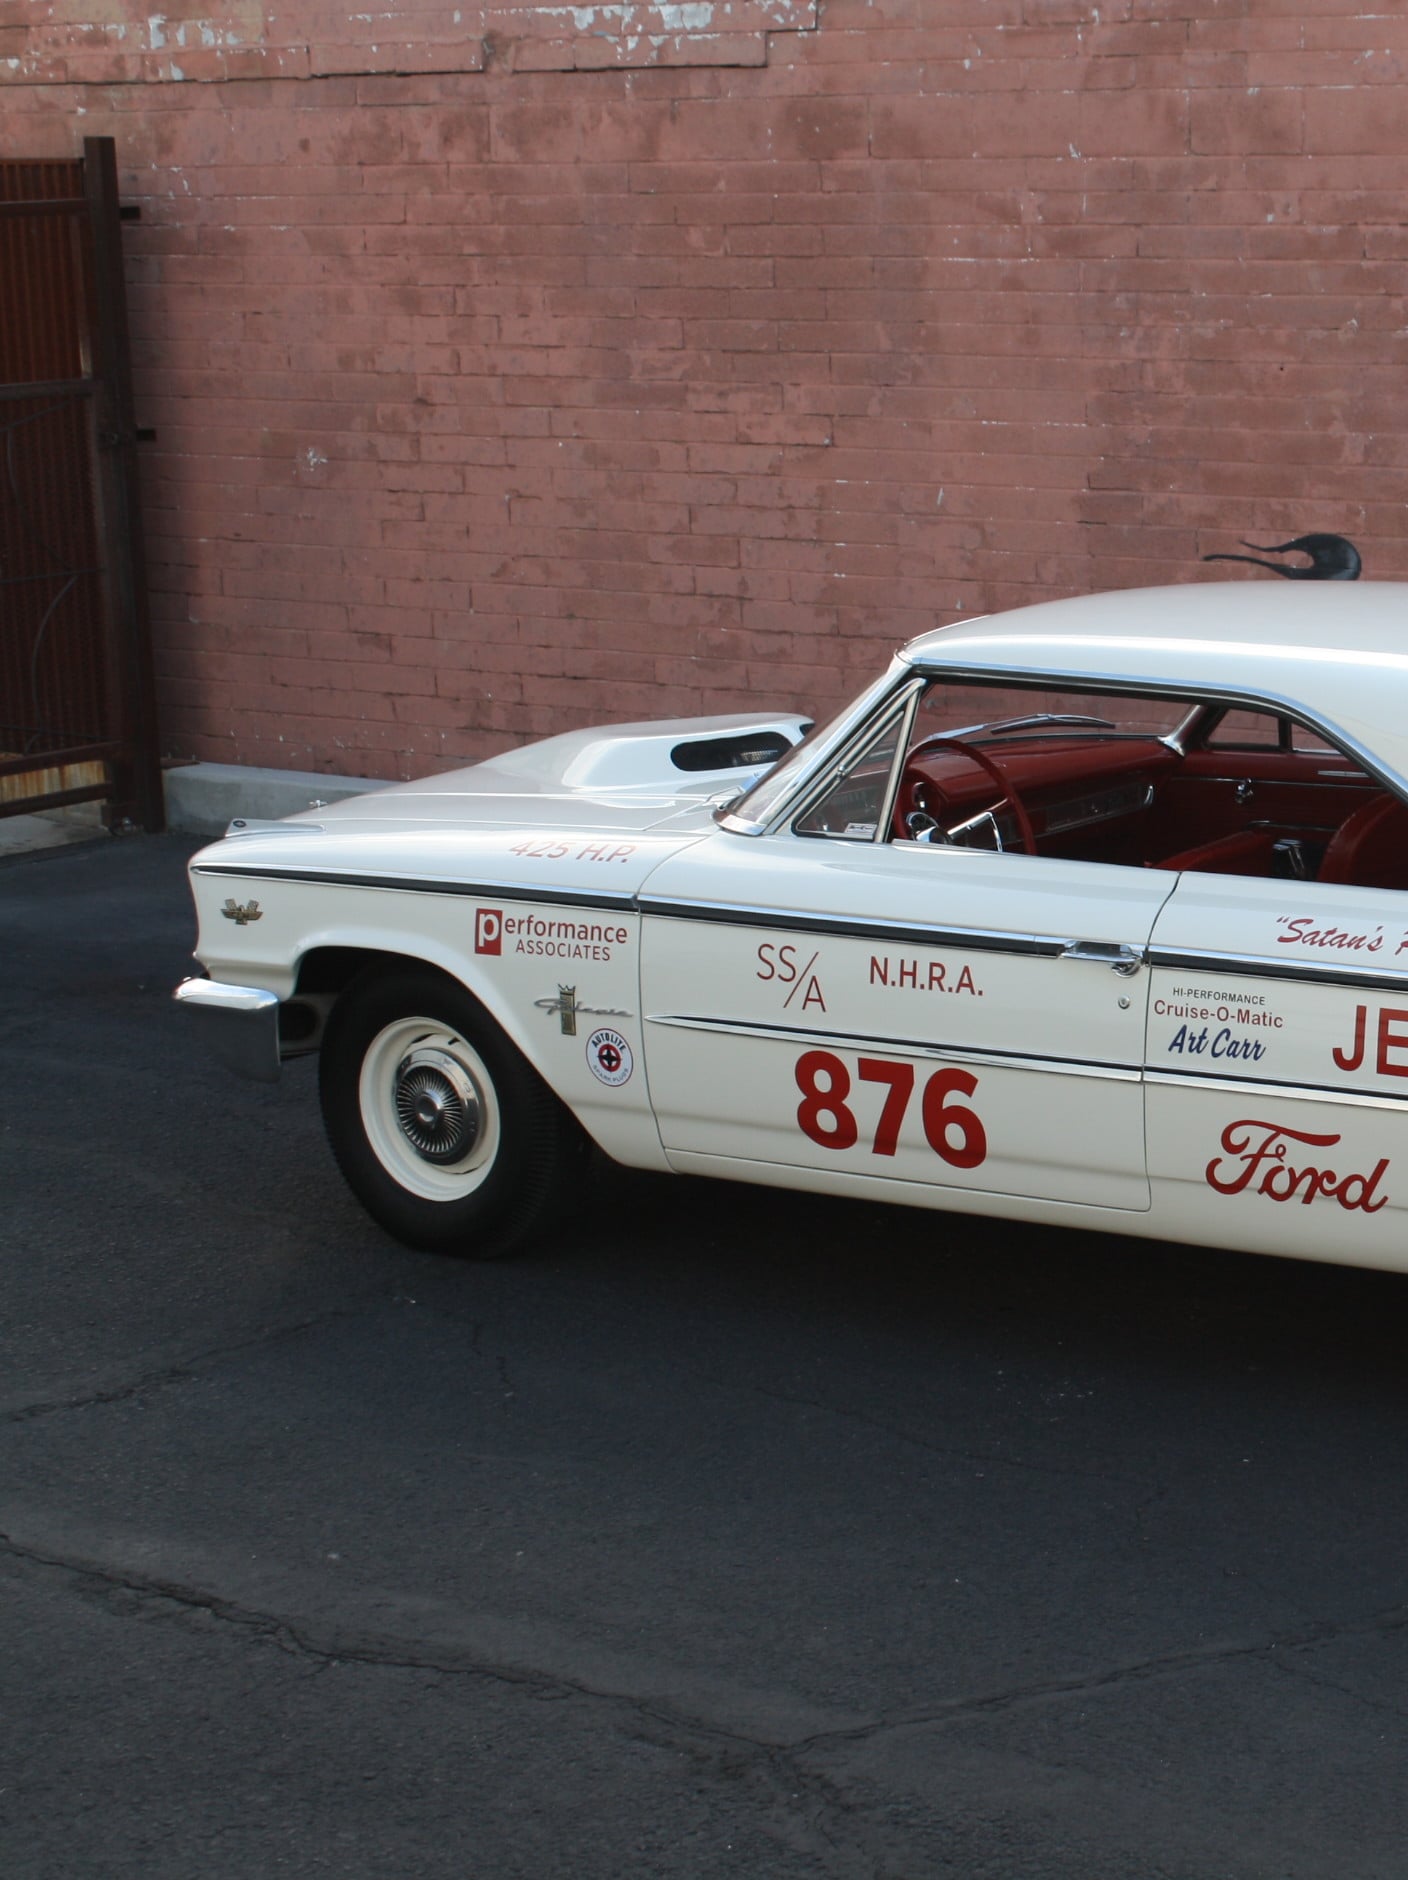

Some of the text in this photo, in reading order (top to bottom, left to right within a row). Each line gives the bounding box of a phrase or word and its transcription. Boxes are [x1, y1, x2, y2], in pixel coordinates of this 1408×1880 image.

[508, 840, 638, 864] 425 H.P.
[477, 911, 628, 949] performance
[515, 938, 612, 962] ASSOCIATES
[869, 956, 984, 997] N.H.R.A.
[1172, 986, 1266, 1006] HI-PERFORMANCE
[1153, 999, 1284, 1029] Cruise-O-Matic
[591, 1031, 627, 1052] AUTOLITE
[1167, 1023, 1267, 1062] Art Carr
[794, 1049, 988, 1170] 876
[1205, 1118, 1391, 1214] Ford
